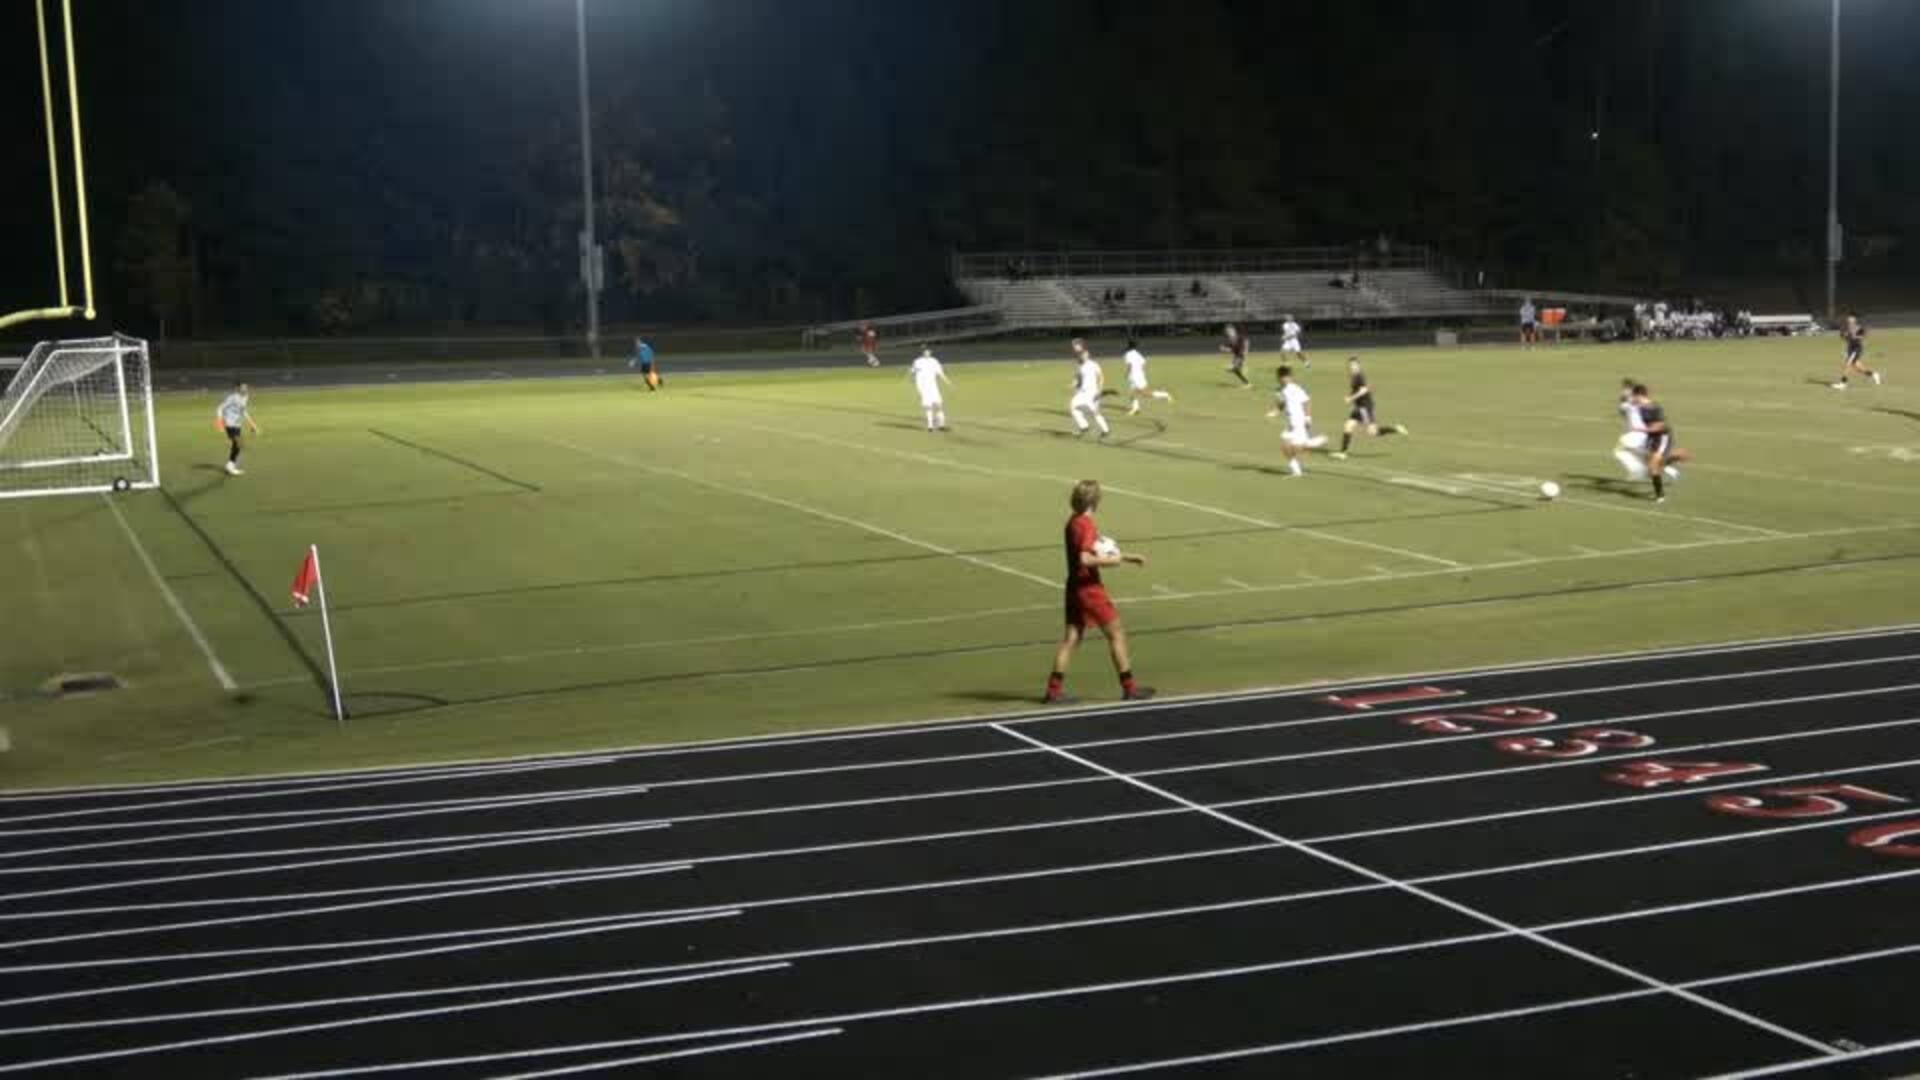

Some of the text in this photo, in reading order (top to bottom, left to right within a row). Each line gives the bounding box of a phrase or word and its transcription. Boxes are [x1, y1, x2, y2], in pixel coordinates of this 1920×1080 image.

[1322, 686, 1466, 711] 1
[1400, 706, 1557, 733] 2
[1495, 728, 1654, 757] 3
[1604, 761, 1769, 787] 4
[1705, 784, 1911, 819] 5
